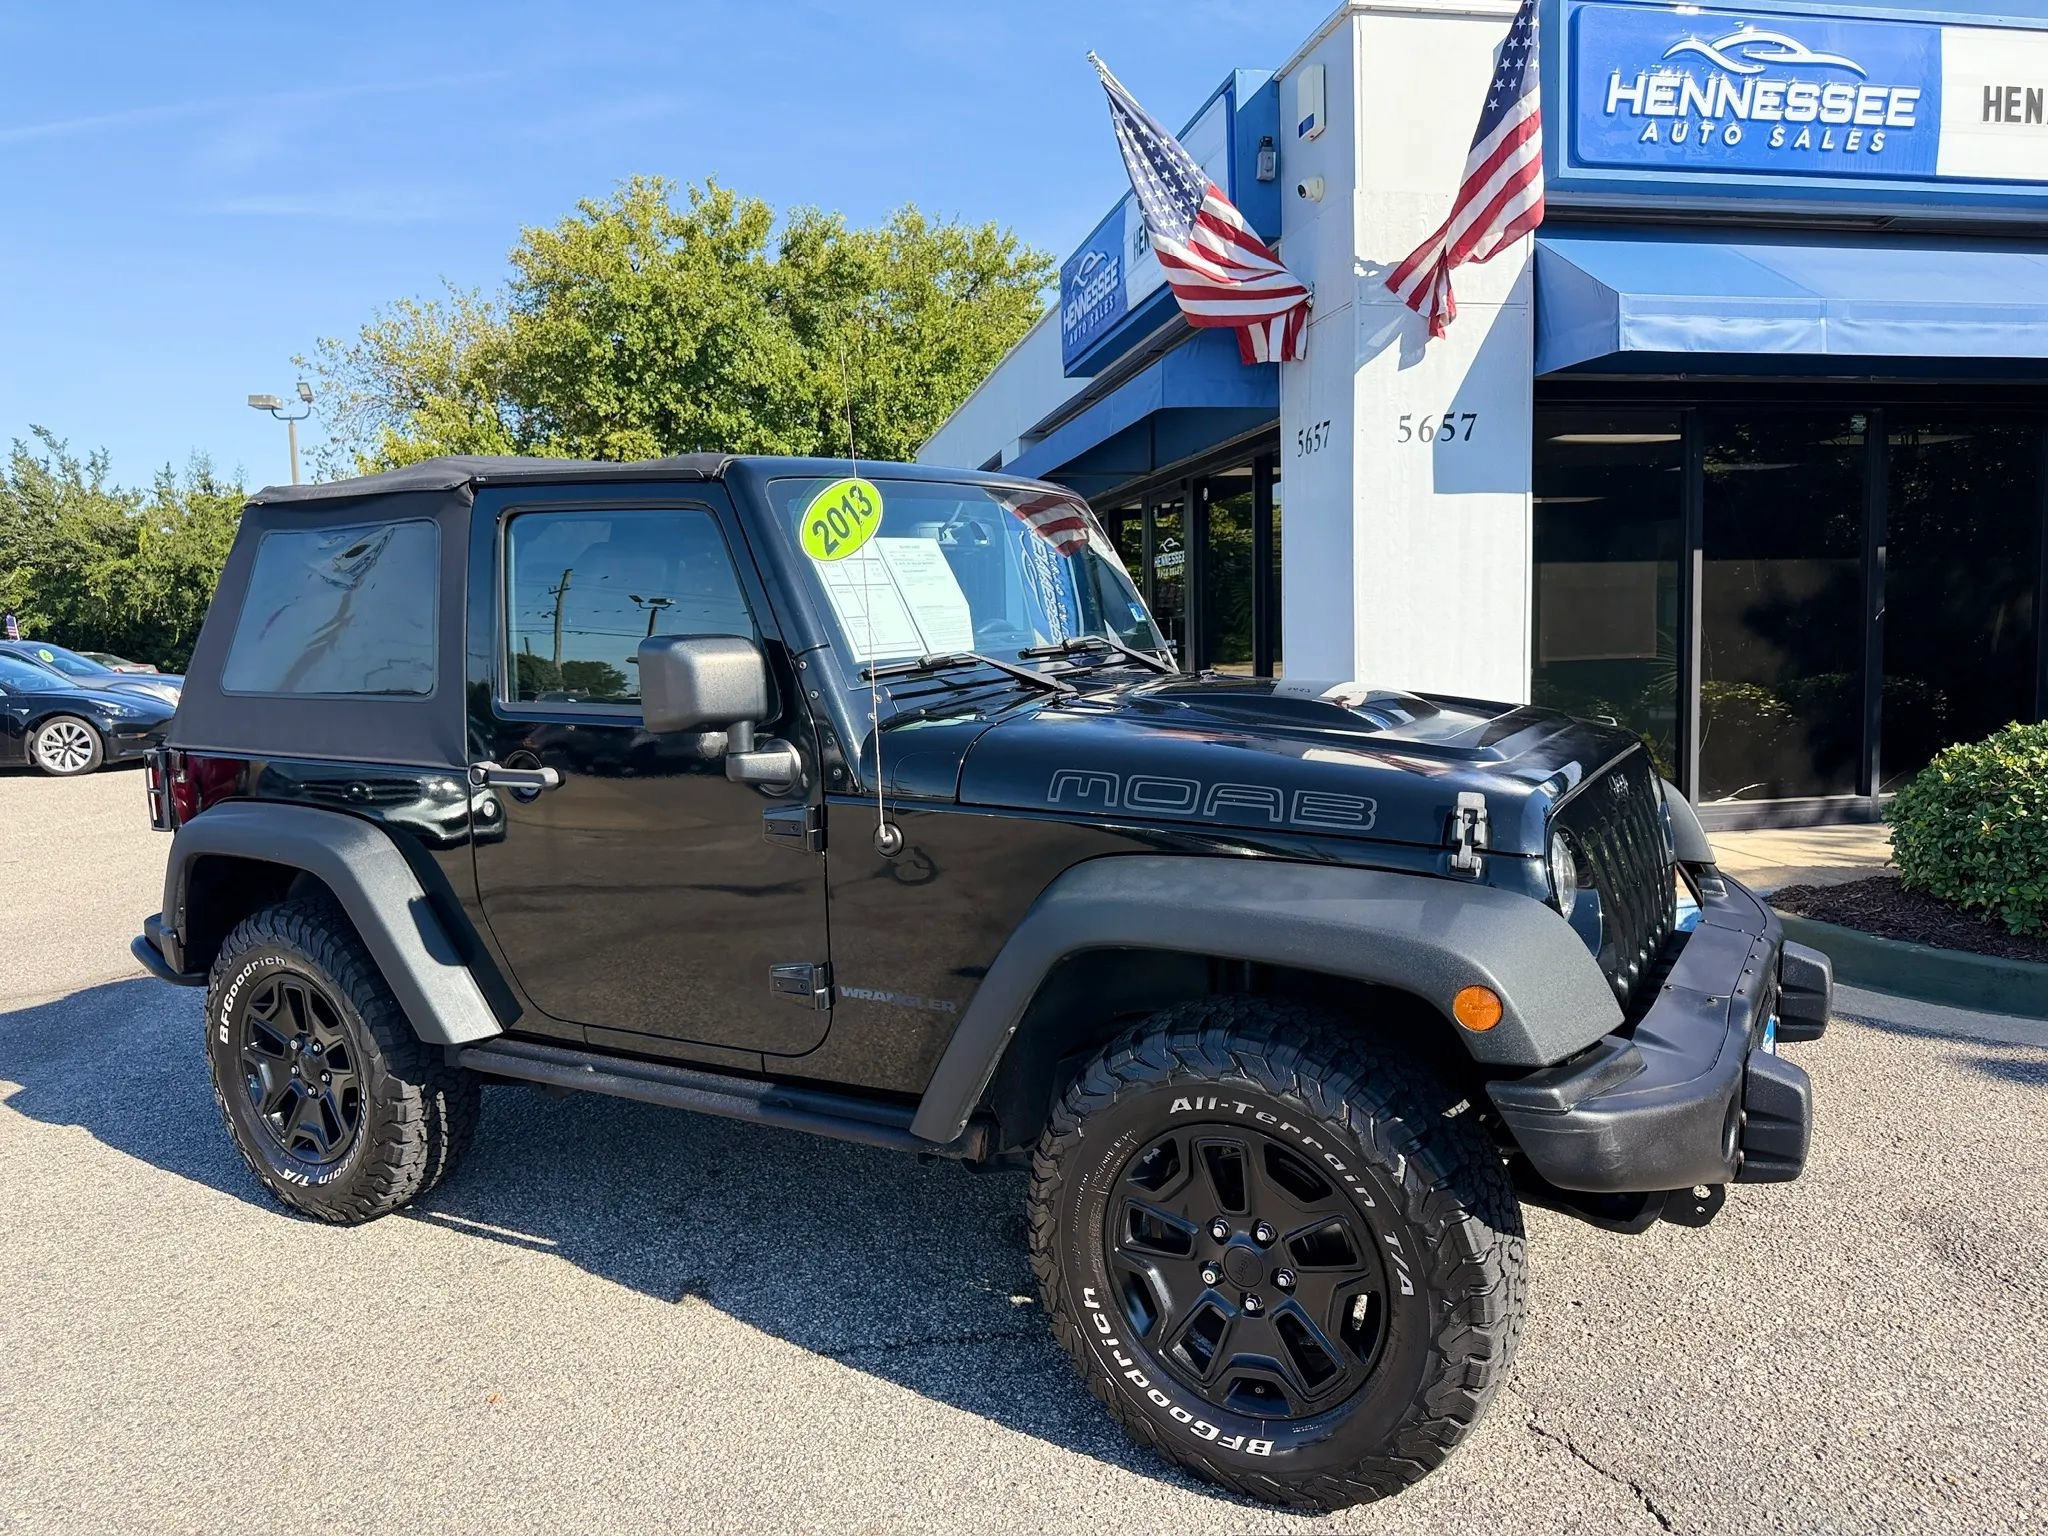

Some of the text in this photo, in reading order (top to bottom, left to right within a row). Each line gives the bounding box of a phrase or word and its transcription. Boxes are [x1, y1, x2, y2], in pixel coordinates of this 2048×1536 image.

[1605, 70, 1921, 127] HENNESSEE
[1982, 85, 2048, 125] HEN
[1640, 119, 1887, 153] AUTO SALES
[1063, 255, 1119, 335] HENNESSEE
[1069, 295, 1115, 346] AUTO SALES
[1297, 420, 1331, 458] 5657
[1397, 411, 1478, 443] 5657
[812, 485, 874, 557] 2013
[1047, 768, 1378, 831] MOAB
[219, 956, 286, 1045] BFGoodrich
[840, 985, 957, 1014] WRANGER
[283, 1168, 310, 1187] T/A
[1169, 1096, 1376, 1208] All-Terrain
[1384, 1231, 1415, 1296] T/A
[1083, 1287, 1274, 1456] BFGoodrich
